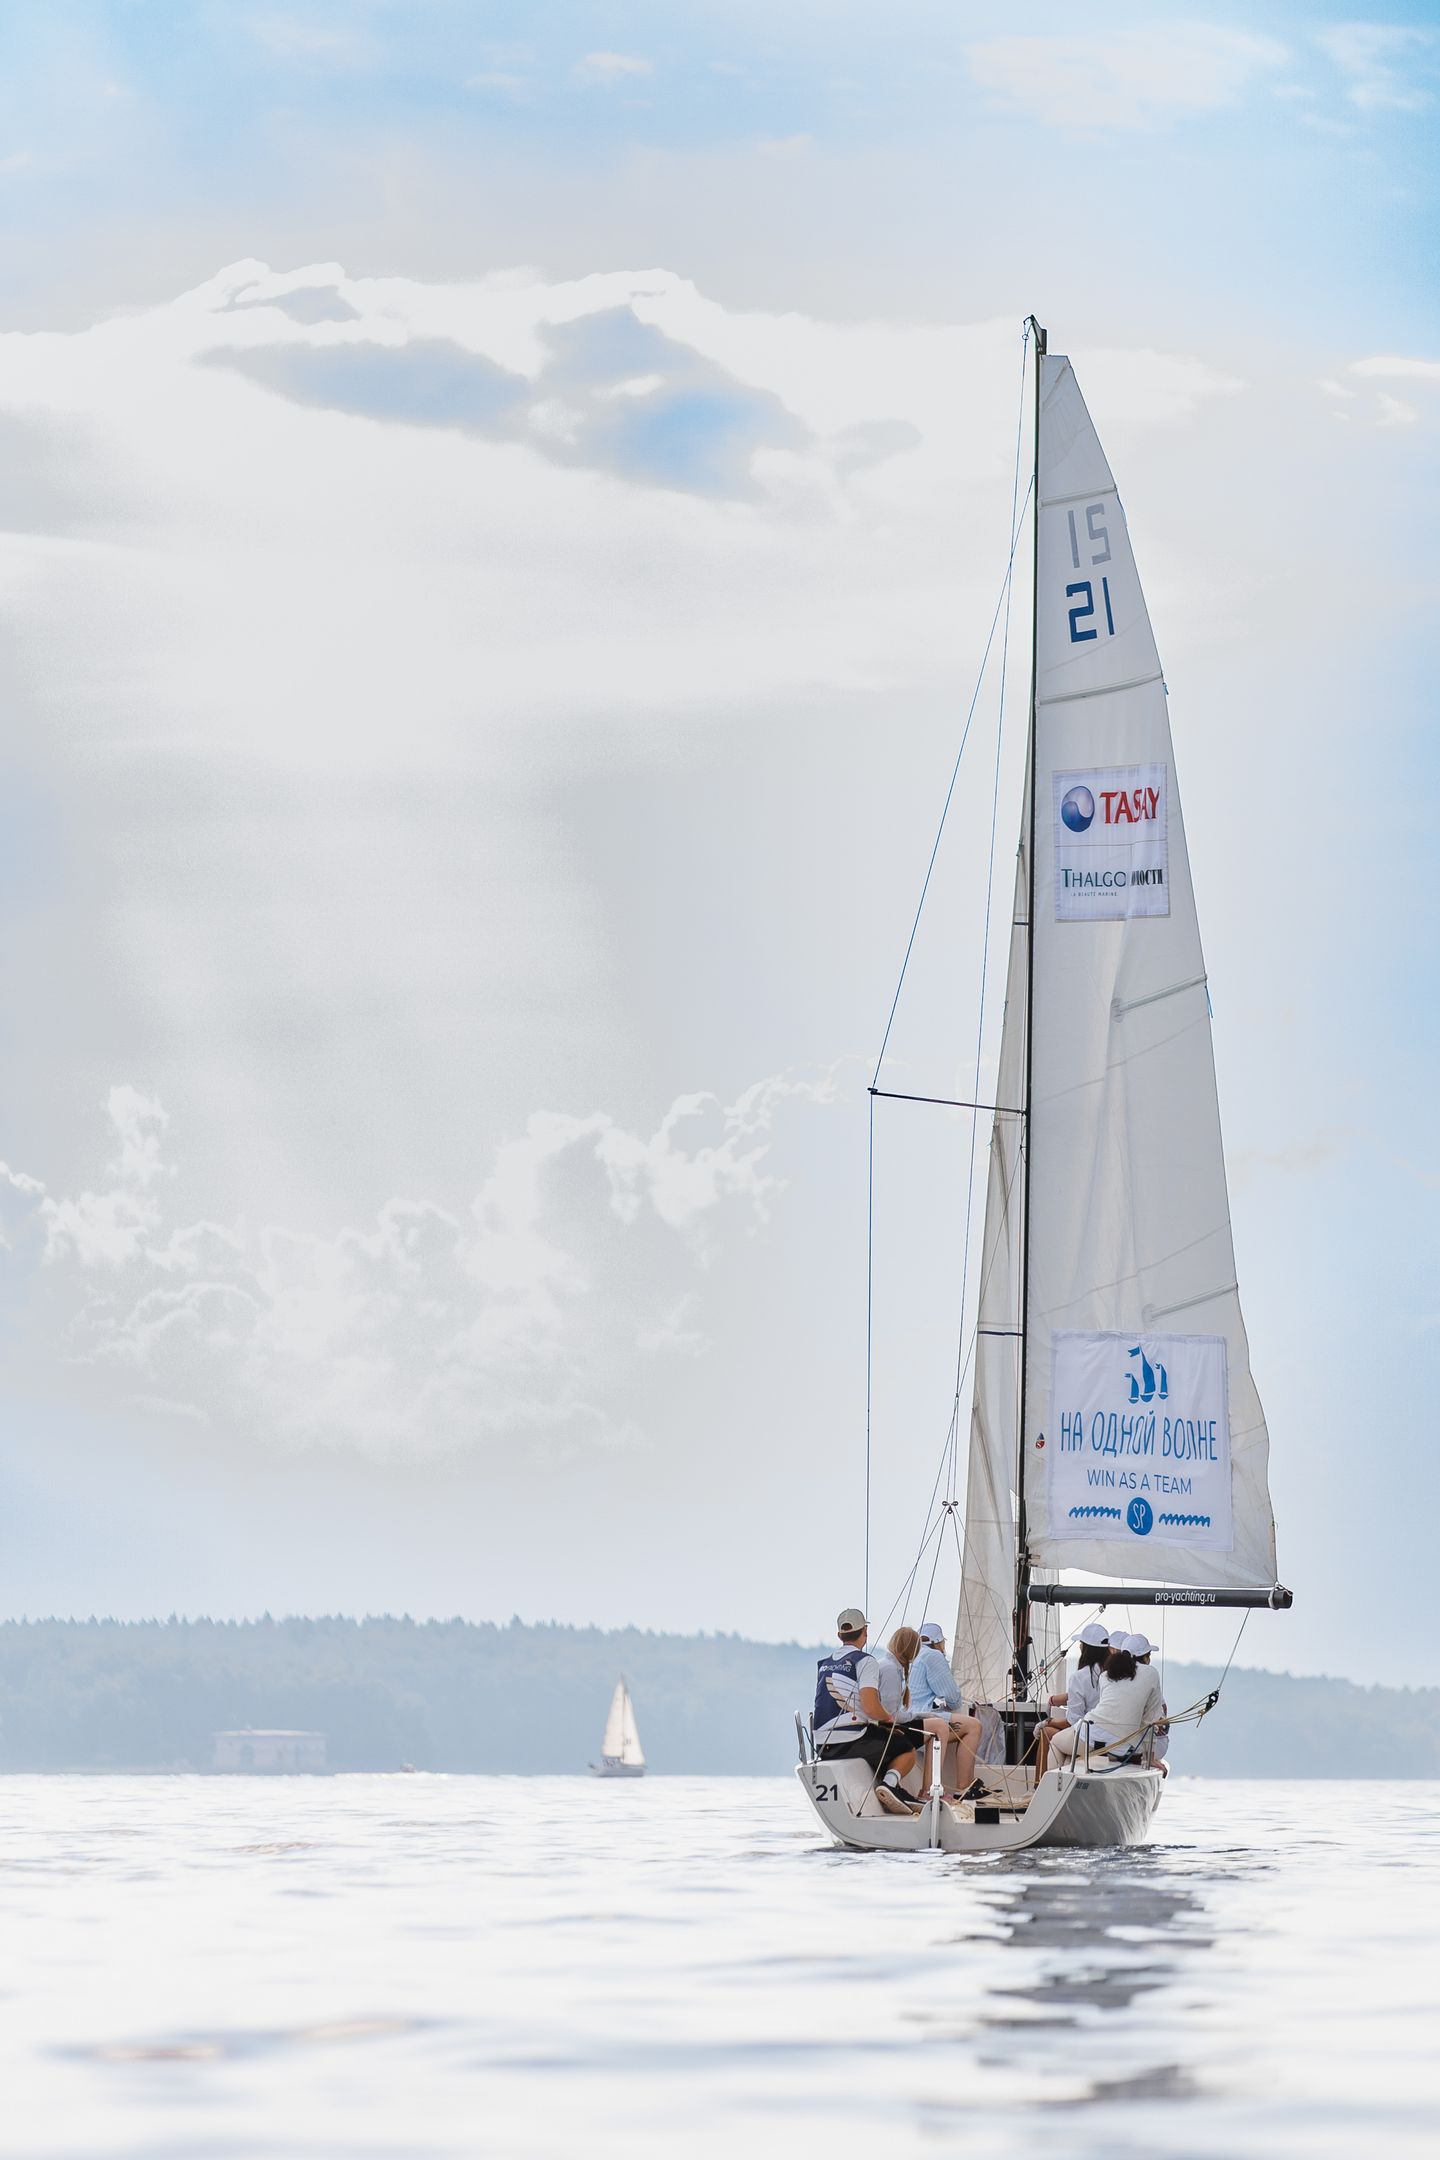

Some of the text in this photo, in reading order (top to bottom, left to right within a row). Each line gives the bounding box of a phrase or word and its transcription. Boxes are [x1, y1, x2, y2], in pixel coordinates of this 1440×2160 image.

[1066, 577, 1115, 643] 21
[1061, 868, 1126, 888] THALGO
[1061, 1410, 1218, 1461] НА ОДНОЙ ВОЛНЕ
[1087, 1469, 1192, 1495] WIN AS A TEAM
[1155, 1590, 1216, 1605] pro-yachting.ru
[816, 1784, 838, 1801] 21
